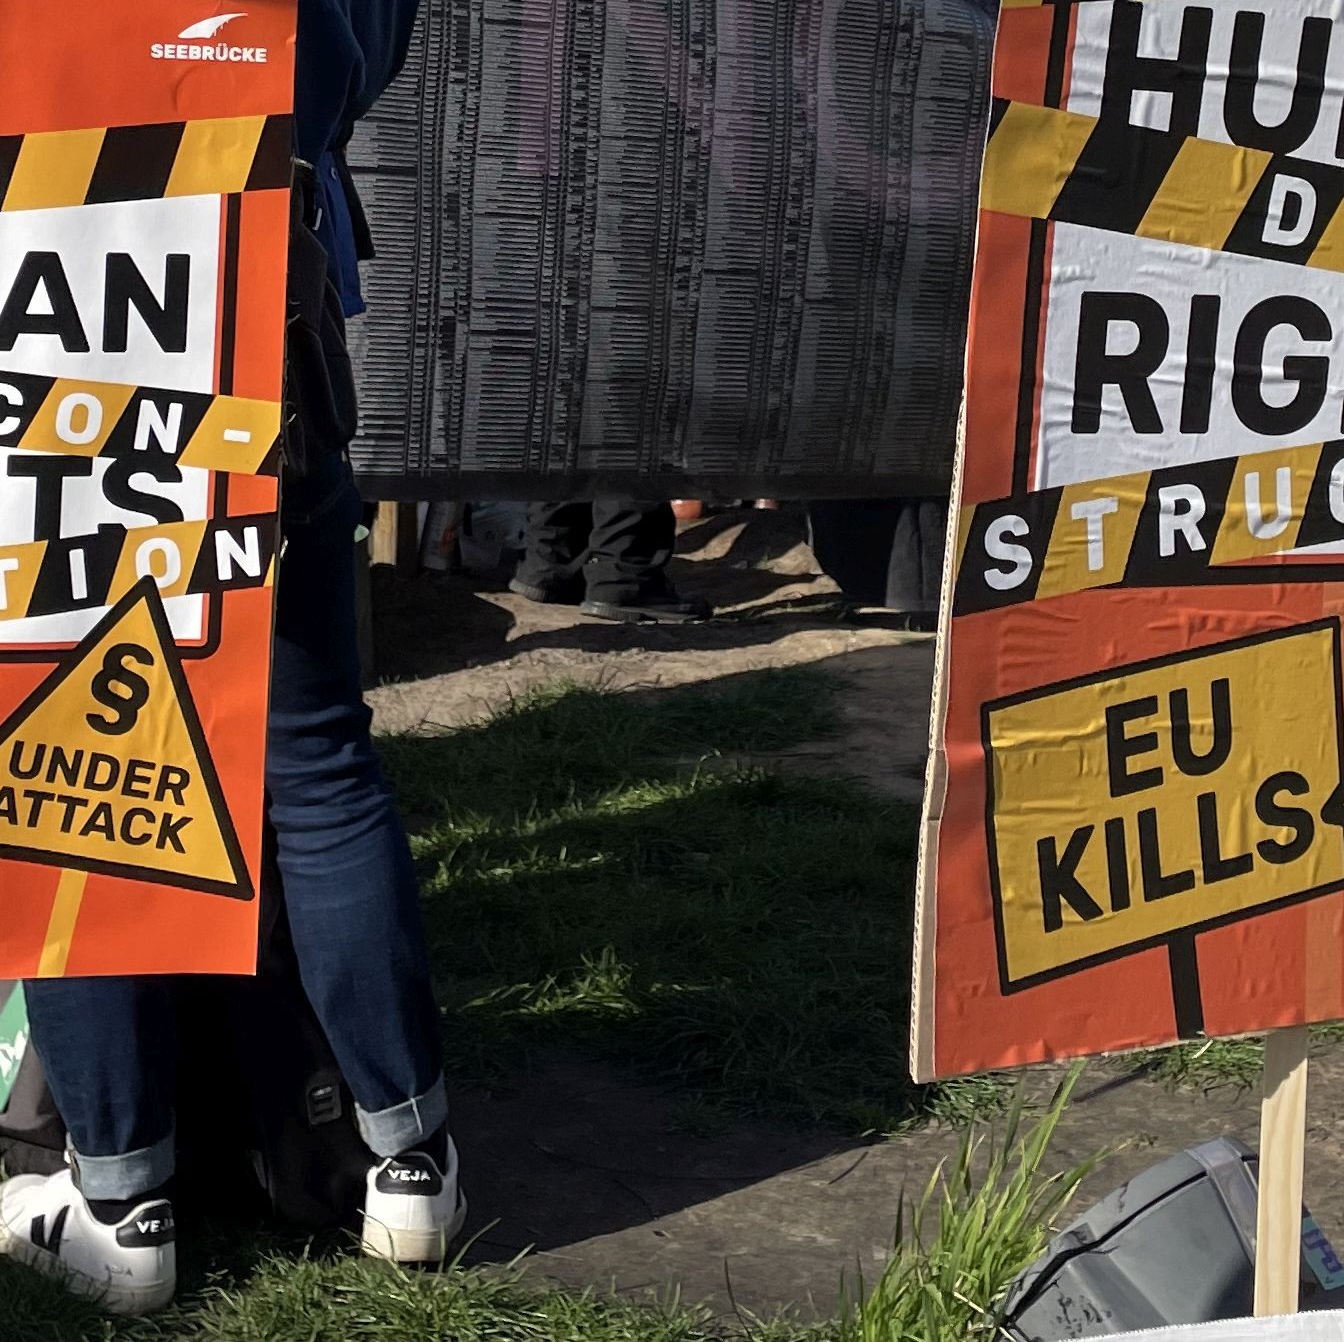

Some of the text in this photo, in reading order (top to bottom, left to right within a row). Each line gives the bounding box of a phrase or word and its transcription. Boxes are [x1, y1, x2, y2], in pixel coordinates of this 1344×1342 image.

[150, 40, 267, 64] SEEBRÜCKE
[1106, 677, 1233, 800] EU
[9, 740, 190, 808] UNDER
[1037, 771, 1316, 935] KILLS
[387, 1168, 431, 1182] VEJA
